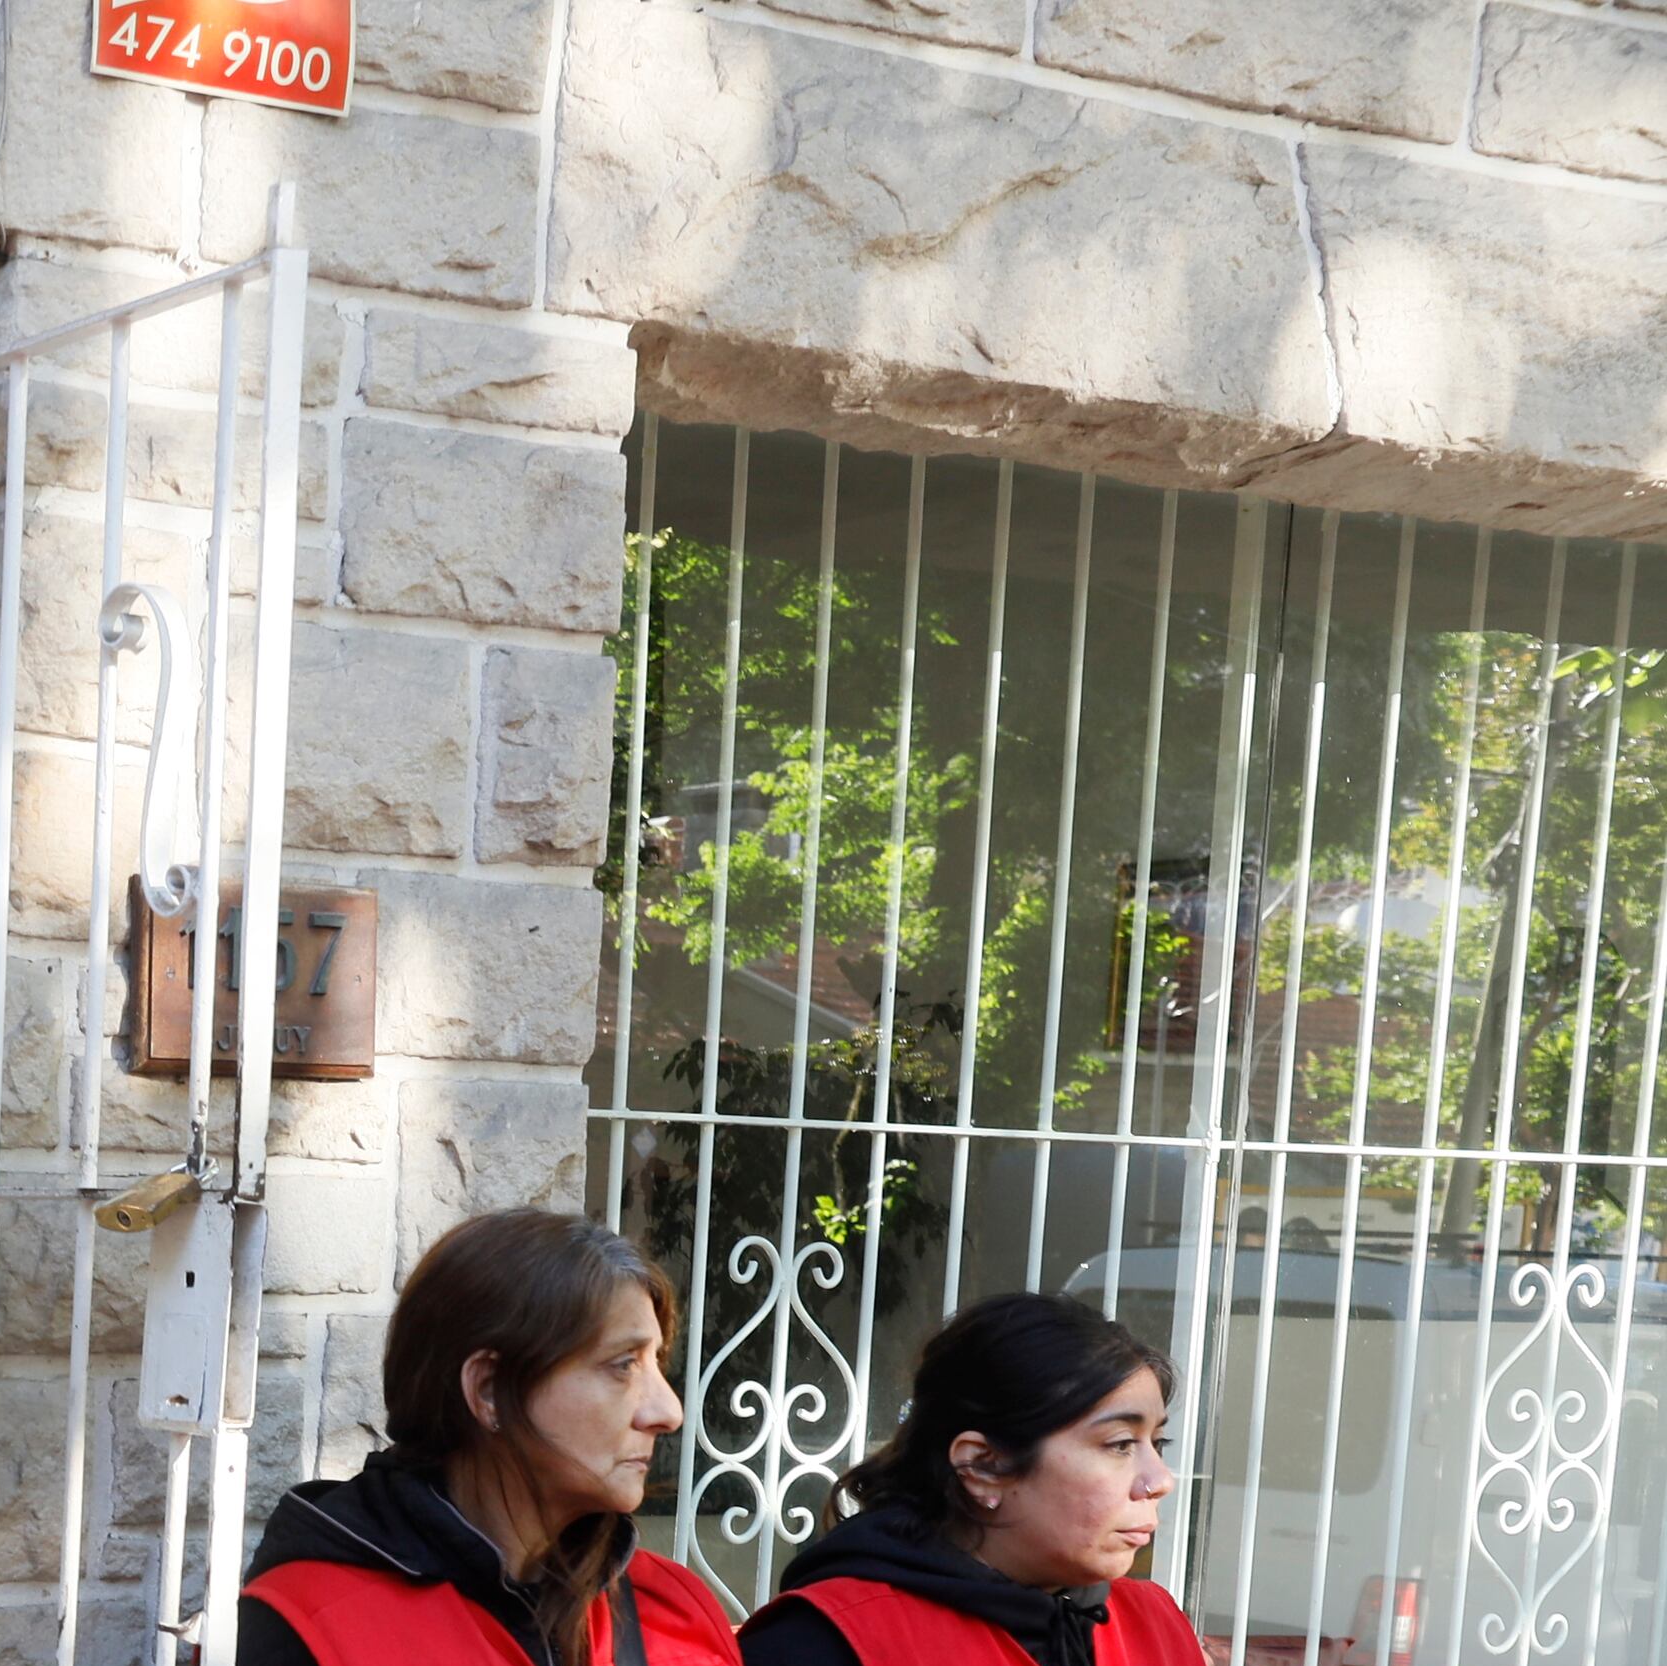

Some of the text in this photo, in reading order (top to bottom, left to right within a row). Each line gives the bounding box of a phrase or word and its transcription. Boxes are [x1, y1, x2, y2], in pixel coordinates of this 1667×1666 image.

[108, 11, 331, 92] 474 9100
[217, 1023, 311, 1055] JUY
